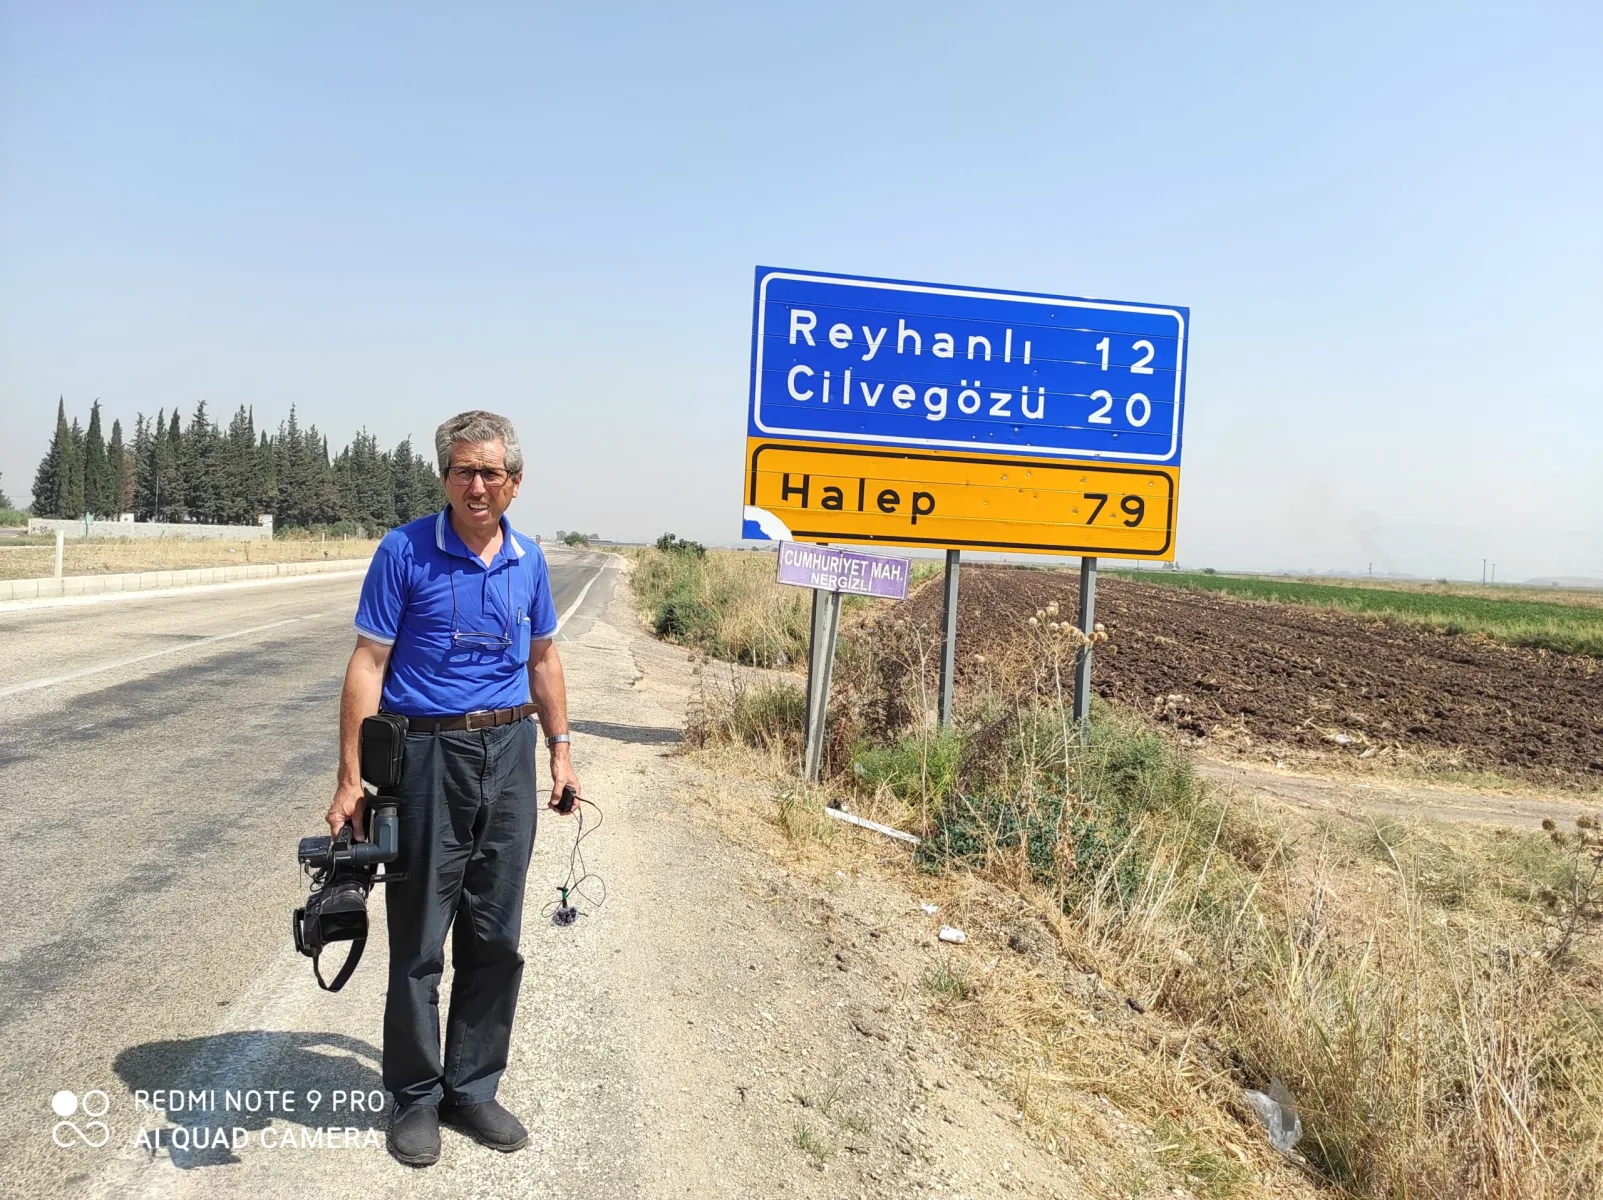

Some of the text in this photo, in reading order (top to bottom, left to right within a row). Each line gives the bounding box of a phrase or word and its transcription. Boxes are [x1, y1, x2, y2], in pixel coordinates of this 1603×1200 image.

[789, 308, 1155, 375] Reyhanlı 12
[787, 364, 1152, 428] Cilvegözü 20
[781, 472, 1145, 528] Halep 79
[784, 549, 904, 582] CUMHURİYET MAH.
[810, 572, 873, 592] NERGİZLİ
